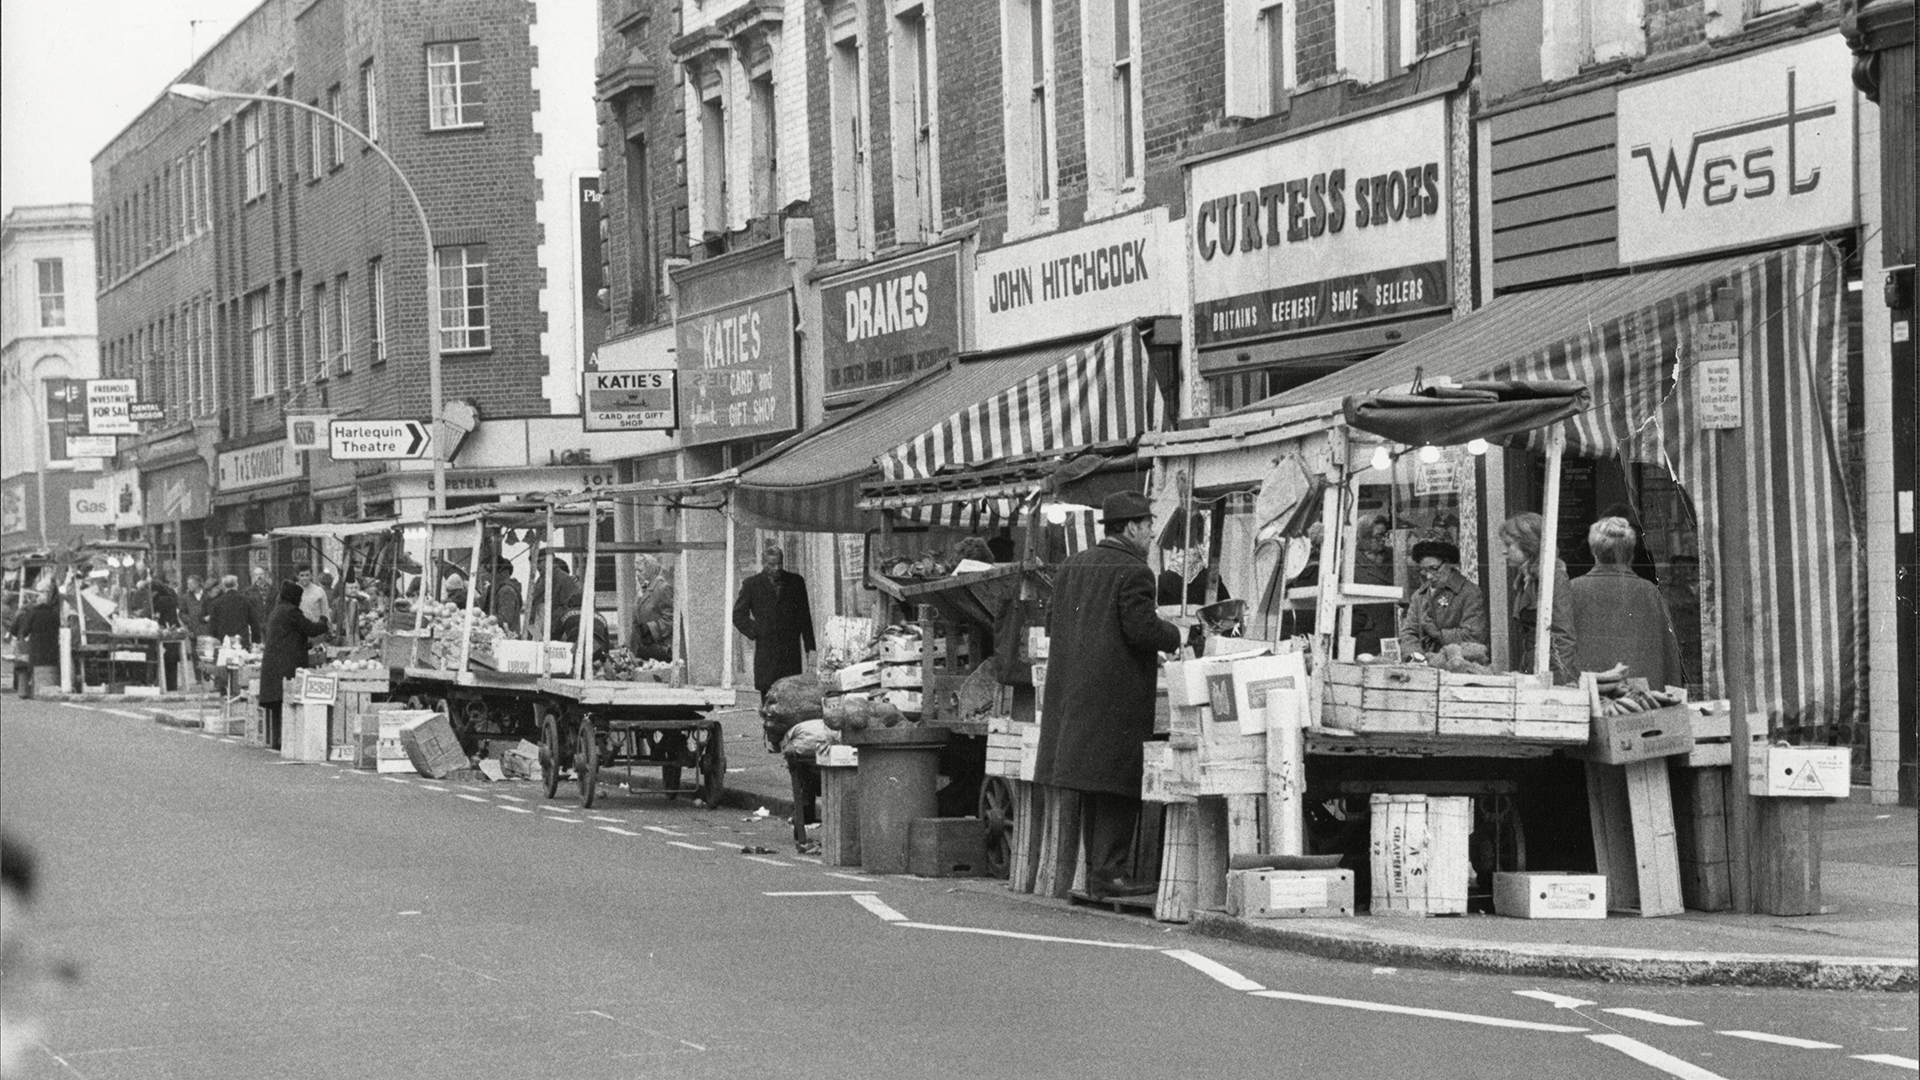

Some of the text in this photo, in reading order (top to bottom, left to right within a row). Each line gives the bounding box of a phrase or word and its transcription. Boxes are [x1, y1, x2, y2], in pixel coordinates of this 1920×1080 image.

[1631, 67, 1837, 214] West
[1197, 162, 1439, 261] CURTESS SHOES
[989, 238, 1149, 313] JOHN HITCHCOCK
[845, 271, 929, 343] DRAKES
[1213, 278, 1423, 332] BRITAINS KEENEST SHOE SELLERS
[703, 306, 761, 370] KATIE'S
[598, 374, 662, 389] KATIE'S
[730, 365, 773, 396] CARD and
[94, 385, 129, 393] FREEHOLD
[90, 396, 138, 404] INVESTMENT
[93, 407, 128, 417] FOR SAL
[132, 404, 160, 412] DENTAL
[728, 396, 776, 427] GIFT SHOP
[335, 426, 403, 438] Harlequin
[342, 441, 396, 452] Theatre
[428, 478, 497, 490] CFETERIA
[76, 500, 108, 513] Gas
